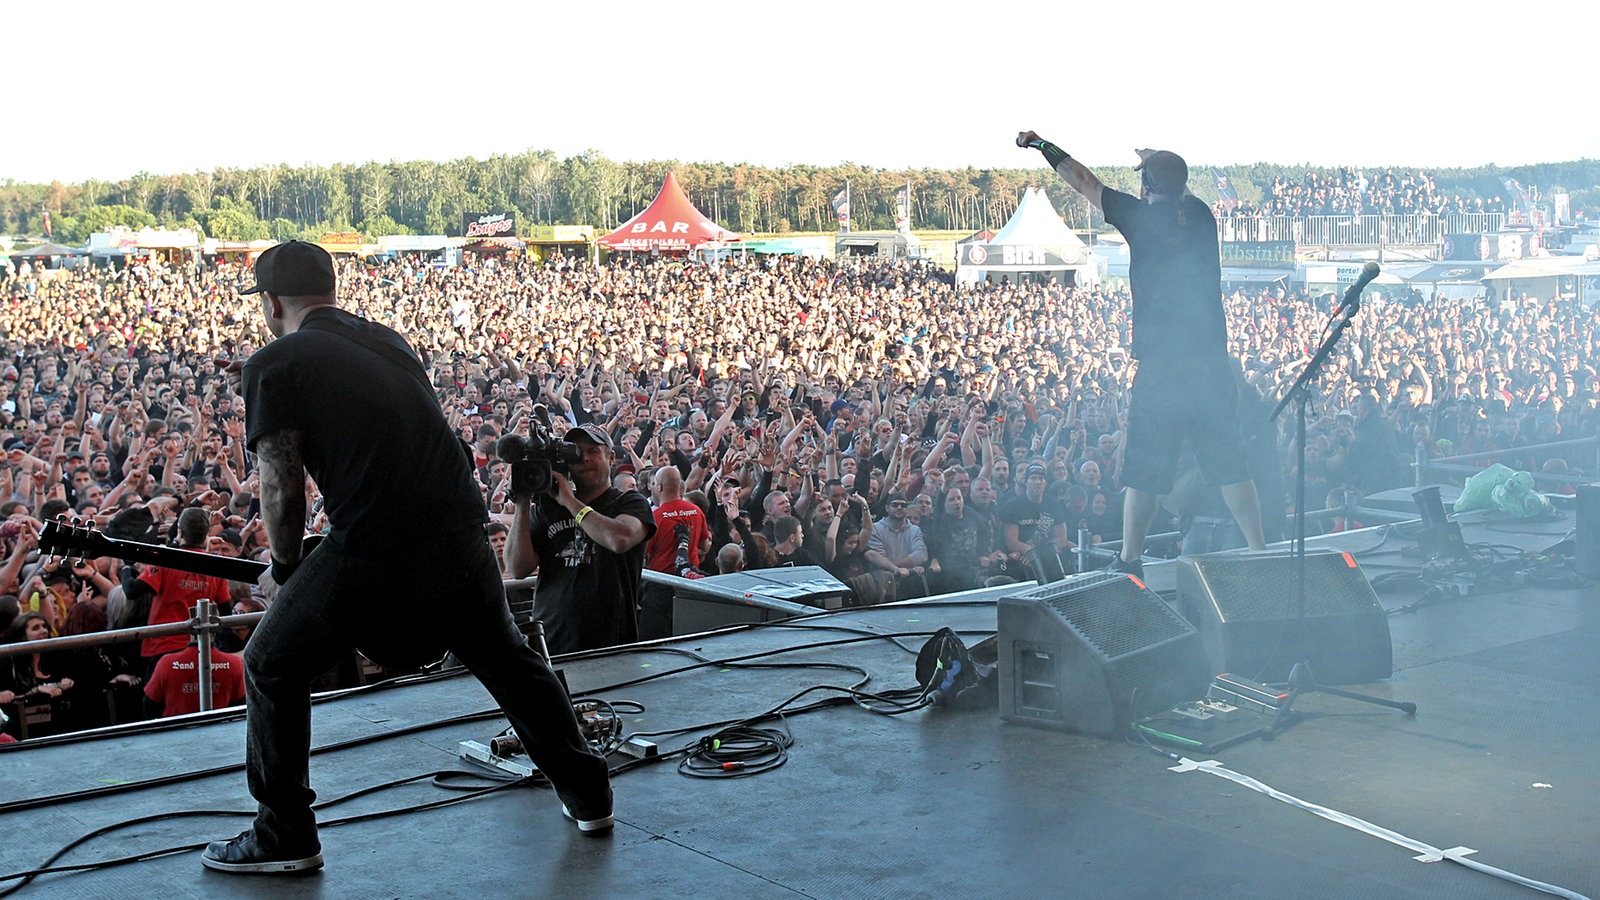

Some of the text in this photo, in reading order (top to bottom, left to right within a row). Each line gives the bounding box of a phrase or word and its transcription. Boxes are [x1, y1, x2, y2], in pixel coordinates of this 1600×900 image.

[466, 219, 514, 237] Langos
[630, 220, 690, 234] BAR
[1003, 245, 1046, 265] BIER
[1222, 244, 1293, 262] Absinth
[662, 509, 698, 518] Band Support
[178, 579, 209, 591] SECURITY
[172, 661, 195, 670] Band
